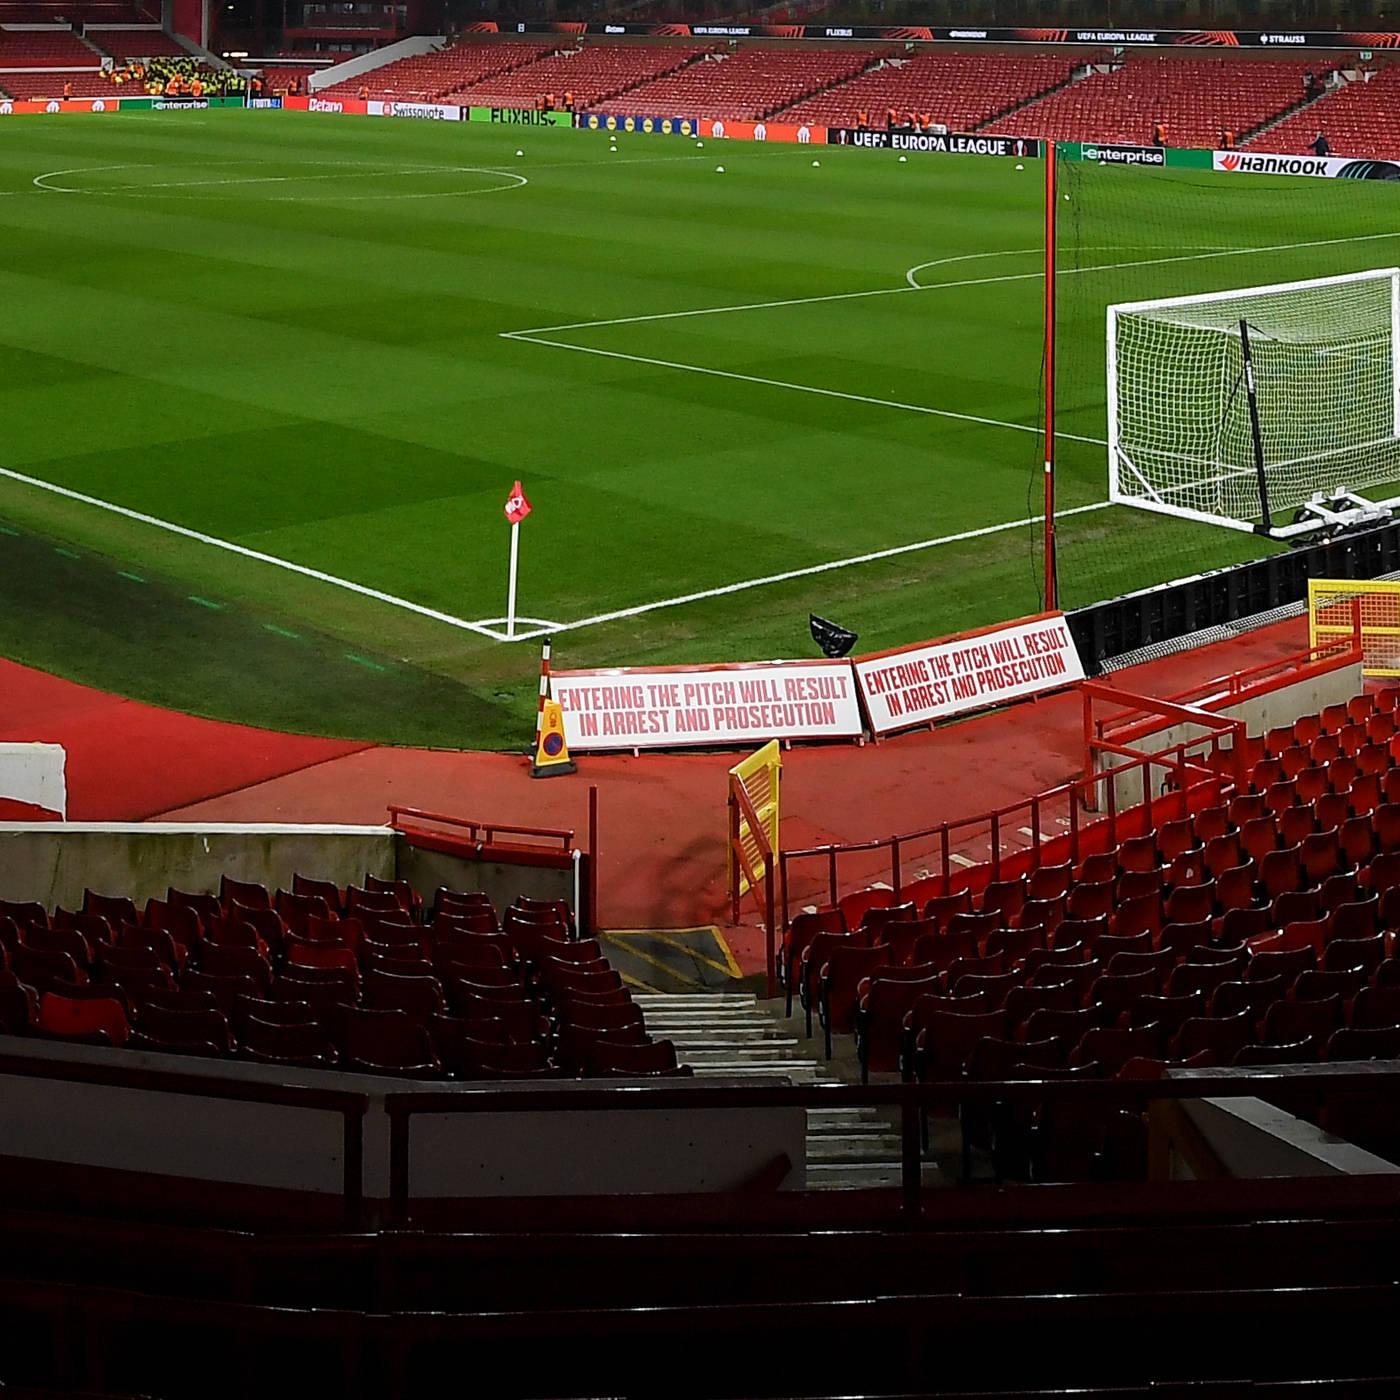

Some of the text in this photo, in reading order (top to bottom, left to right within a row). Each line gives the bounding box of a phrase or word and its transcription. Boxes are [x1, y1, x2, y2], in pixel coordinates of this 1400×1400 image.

[1269, 35, 1306, 43] STRAUSS
[394, 103, 444, 119] Swissquote
[854, 132, 1006, 155] UEFA EUROPA LEAGUE
[1083, 148, 1163, 164] enterprise
[864, 627, 1069, 695] ENTERING THE PITCH WILL RESULT
[558, 677, 847, 712] ENTERING THE PITCH WILL RESULT
[885, 652, 1067, 717] IN ARREST AND PROSECUTION
[580, 713, 598, 736] IN
[603, 710, 669, 735] ARREST
[675, 707, 710, 732] AND
[713, 702, 836, 731] PROSECUTION
